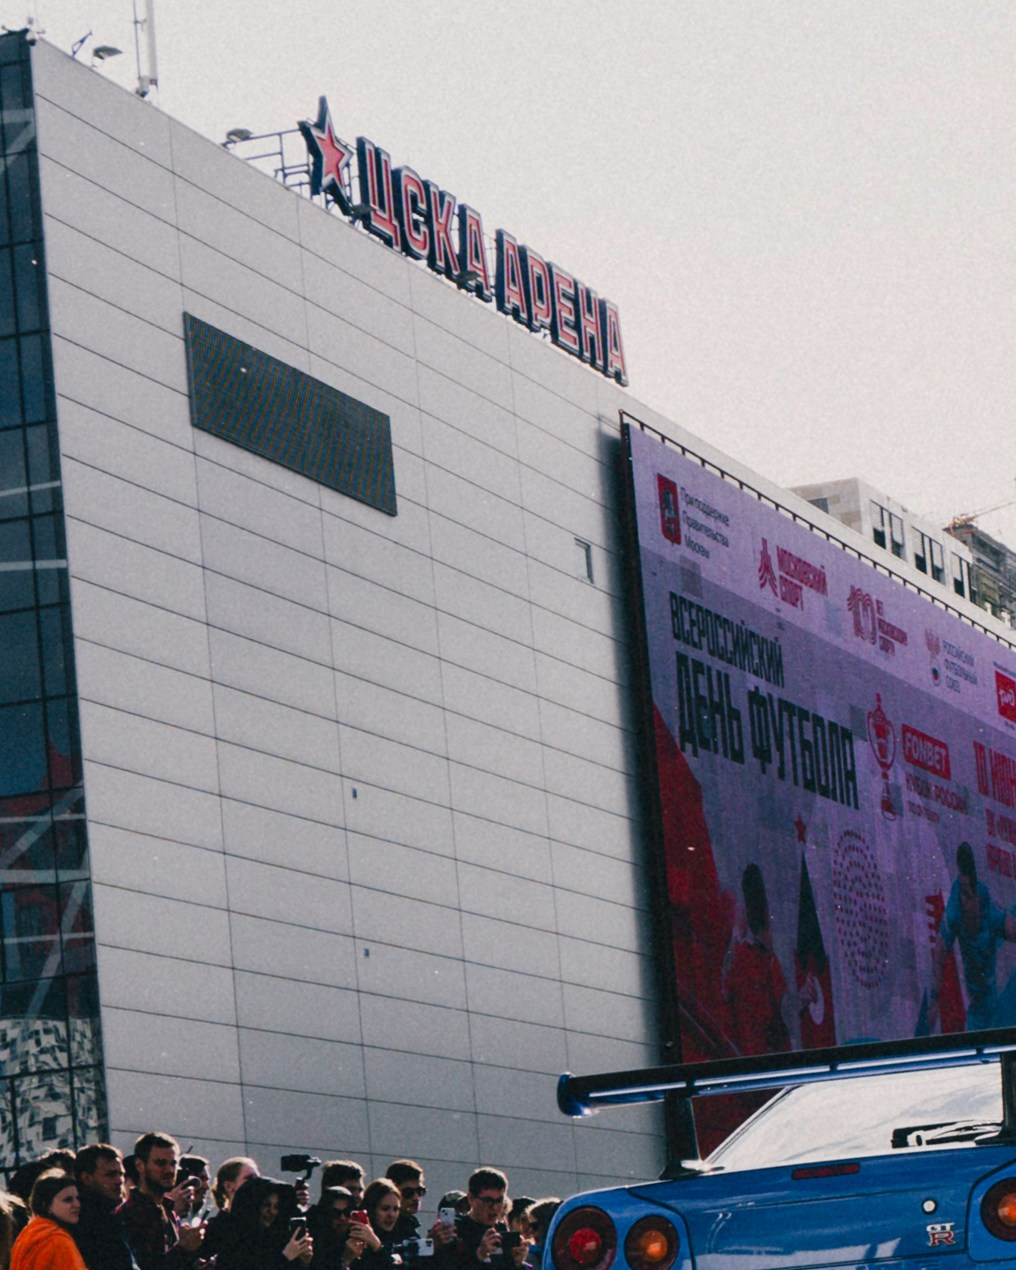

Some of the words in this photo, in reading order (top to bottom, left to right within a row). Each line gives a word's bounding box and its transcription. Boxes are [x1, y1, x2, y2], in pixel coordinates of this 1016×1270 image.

[356, 136, 493, 303] ЦСКА
[495, 228, 629, 388] АРЕНА
[669, 591, 785, 689] ВСЕРОССИЙСКИЙ
[675, 651, 746, 765] ДЕНЬ
[748, 685, 860, 811] ФУТБОЛА
[904, 730, 948, 772] FONBET
